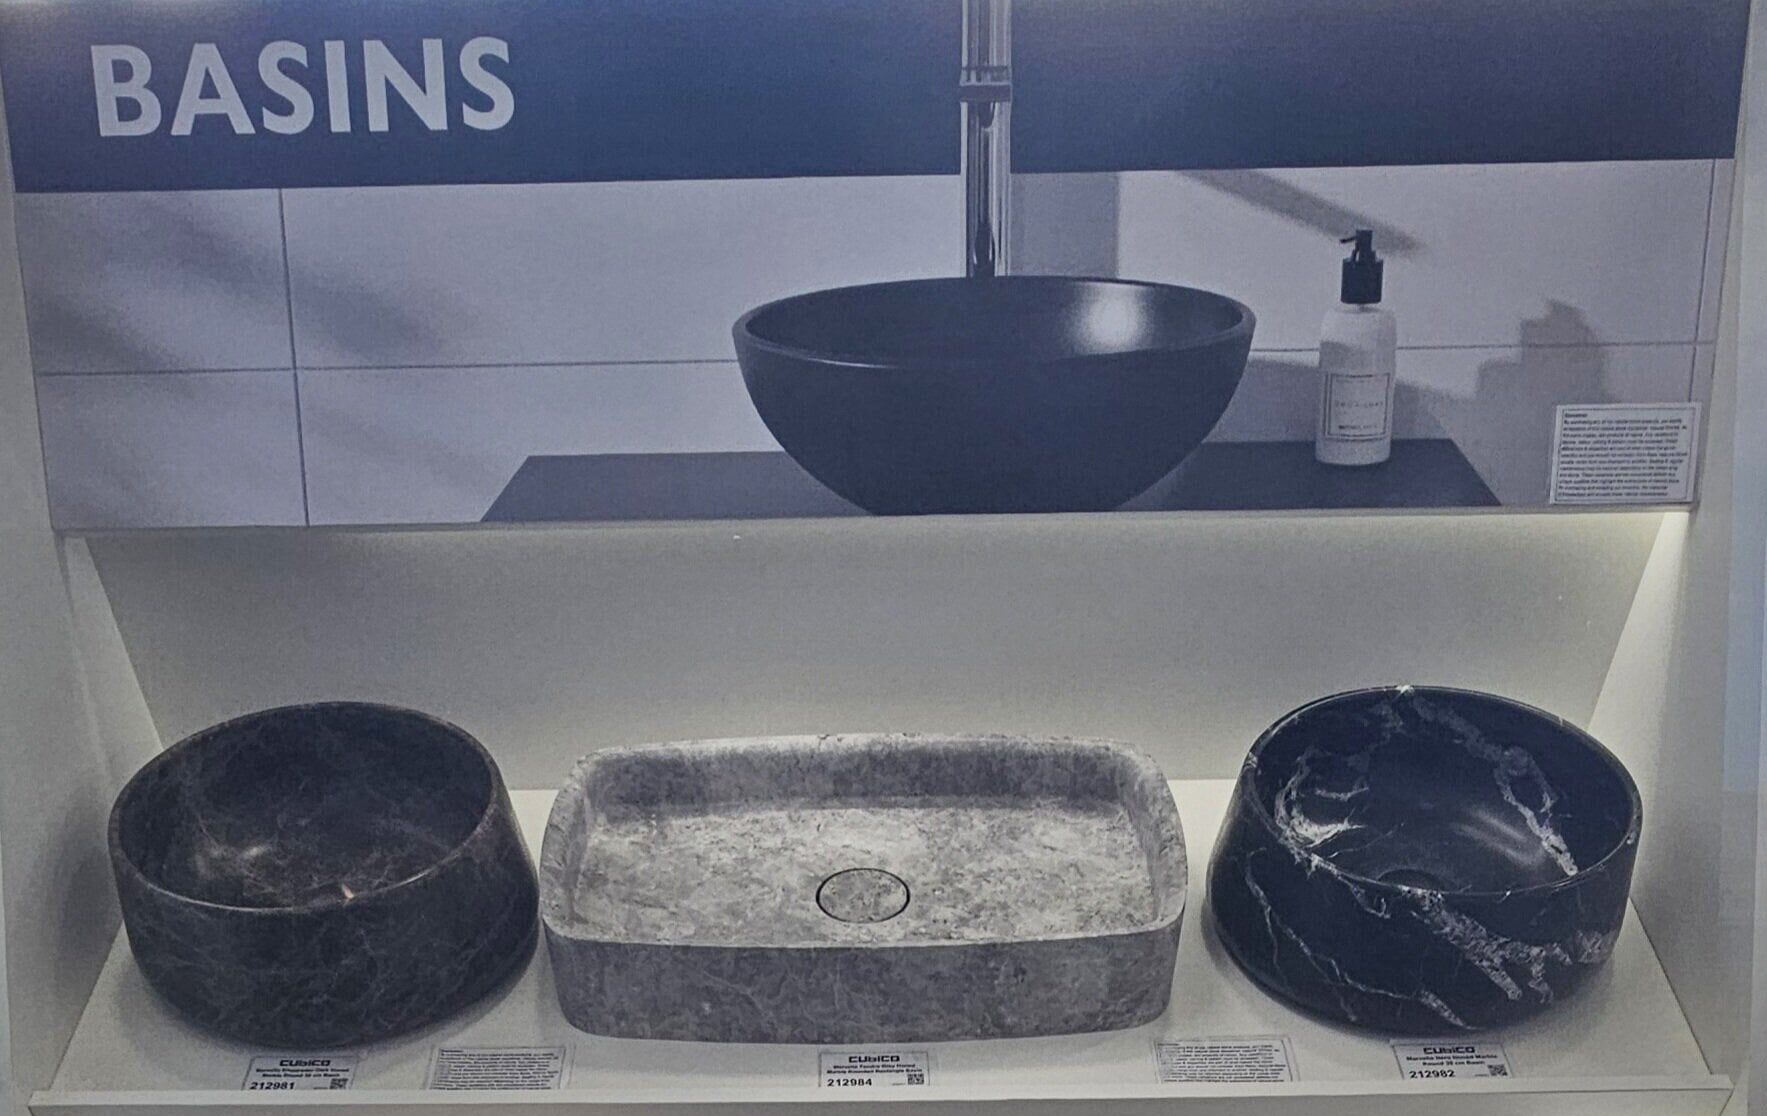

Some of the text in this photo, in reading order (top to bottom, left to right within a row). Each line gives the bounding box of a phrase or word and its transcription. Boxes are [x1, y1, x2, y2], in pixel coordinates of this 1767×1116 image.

[91, 37, 515, 138] BASINS
[1409, 1070, 1455, 1078] 212982
[250, 1082, 295, 1090] 212981
[827, 1078, 872, 1087] 212984
